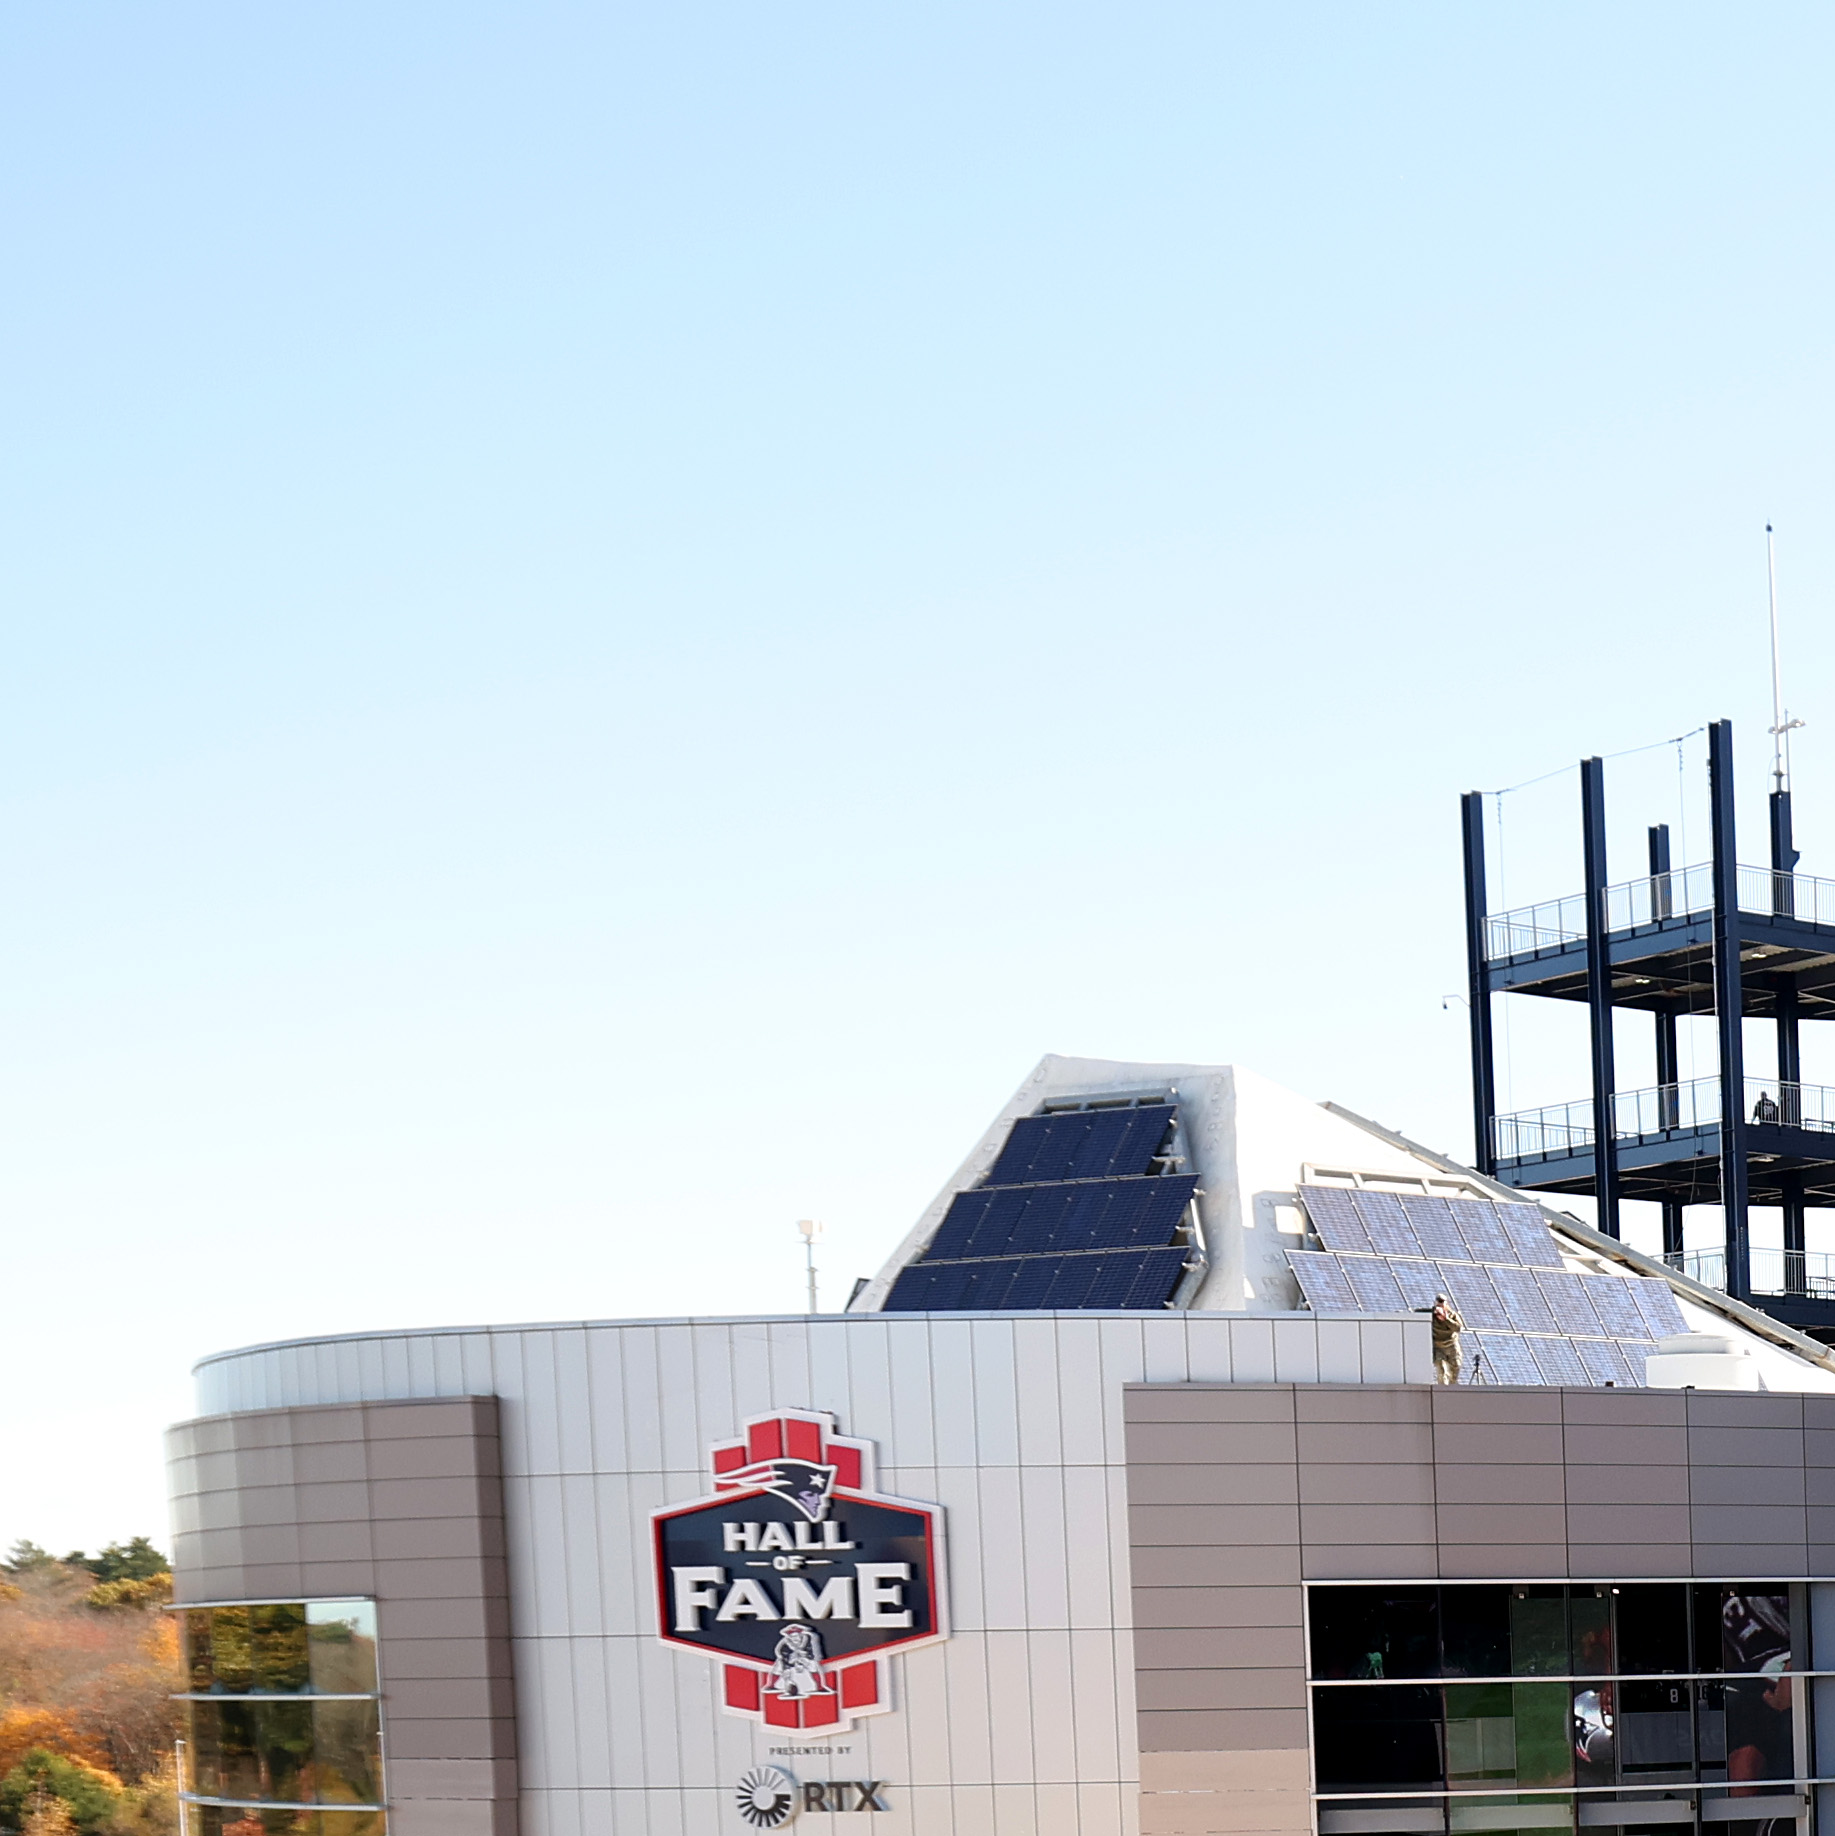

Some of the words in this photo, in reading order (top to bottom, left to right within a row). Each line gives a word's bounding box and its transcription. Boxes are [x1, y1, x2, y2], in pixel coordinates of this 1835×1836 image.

[722, 1520, 855, 1552] HALL
[773, 1555, 804, 1571] OF
[671, 1562, 914, 1632] FAME
[769, 1746, 827, 1756] PRESENTED
[832, 1746, 851, 1755] BY
[804, 1781, 886, 1812] RTX
